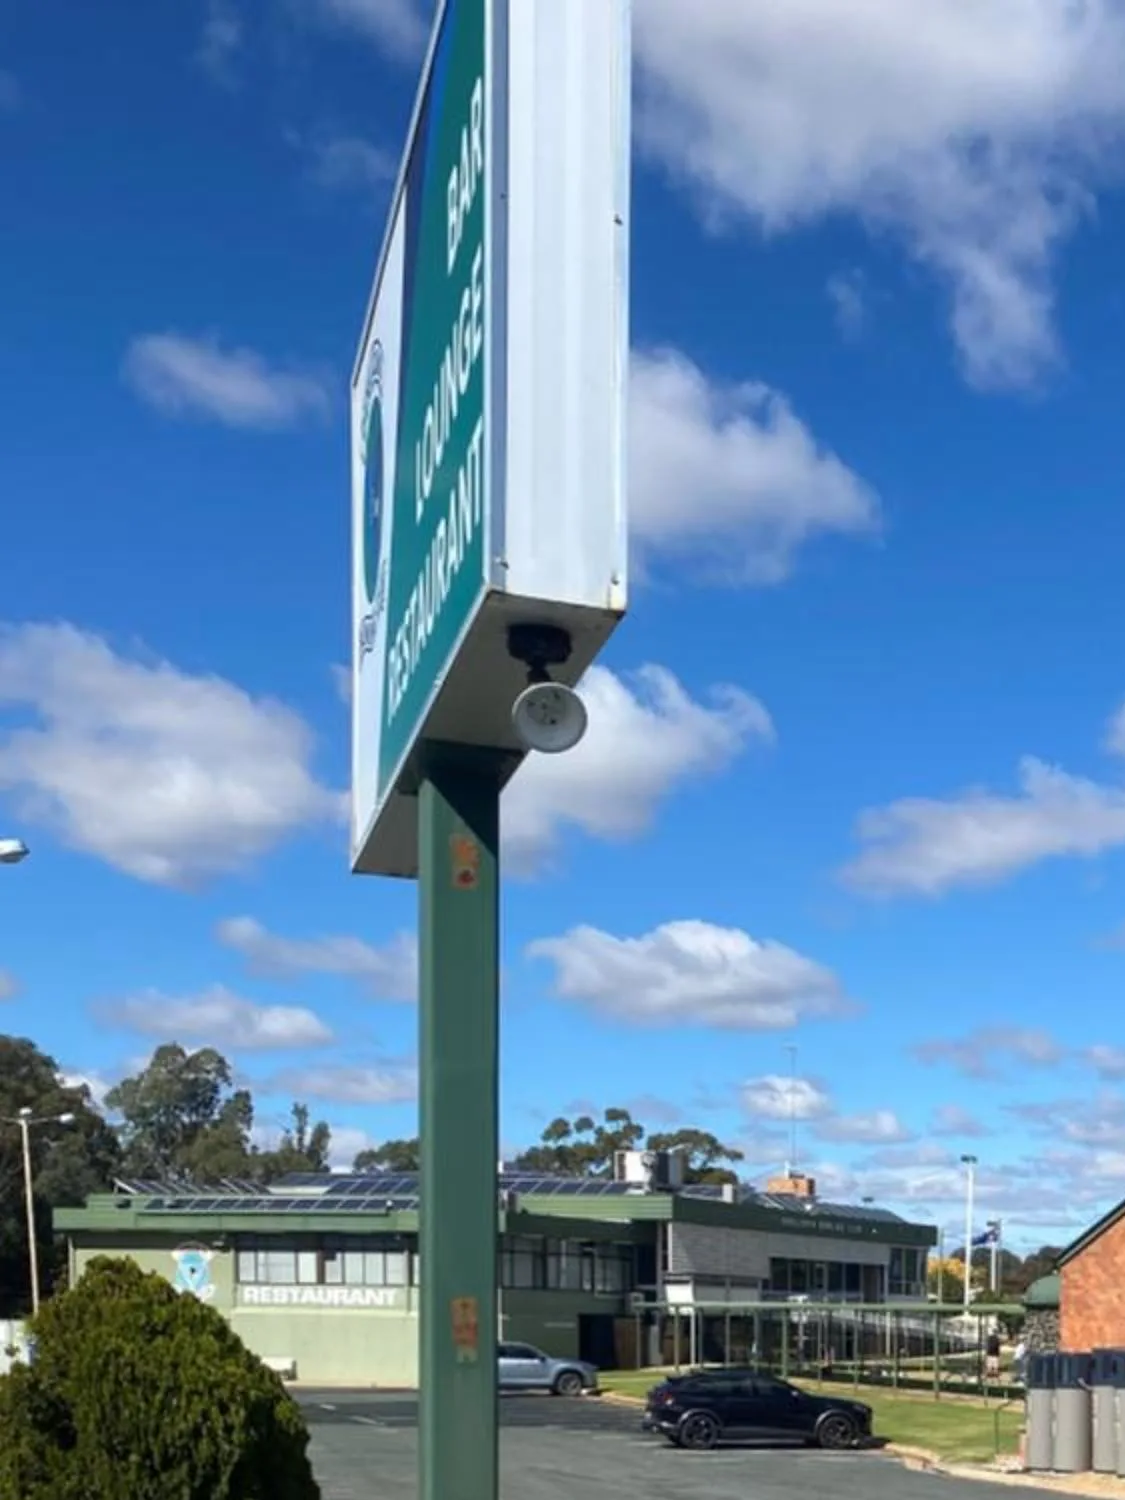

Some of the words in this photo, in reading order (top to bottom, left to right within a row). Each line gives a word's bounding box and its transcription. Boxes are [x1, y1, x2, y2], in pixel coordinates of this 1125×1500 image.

[447, 76, 482, 277] BAR
[415, 242, 482, 525] LOUNGE
[387, 415, 482, 726] RESTAURANT
[244, 1287, 396, 1306] RESTAURANT
